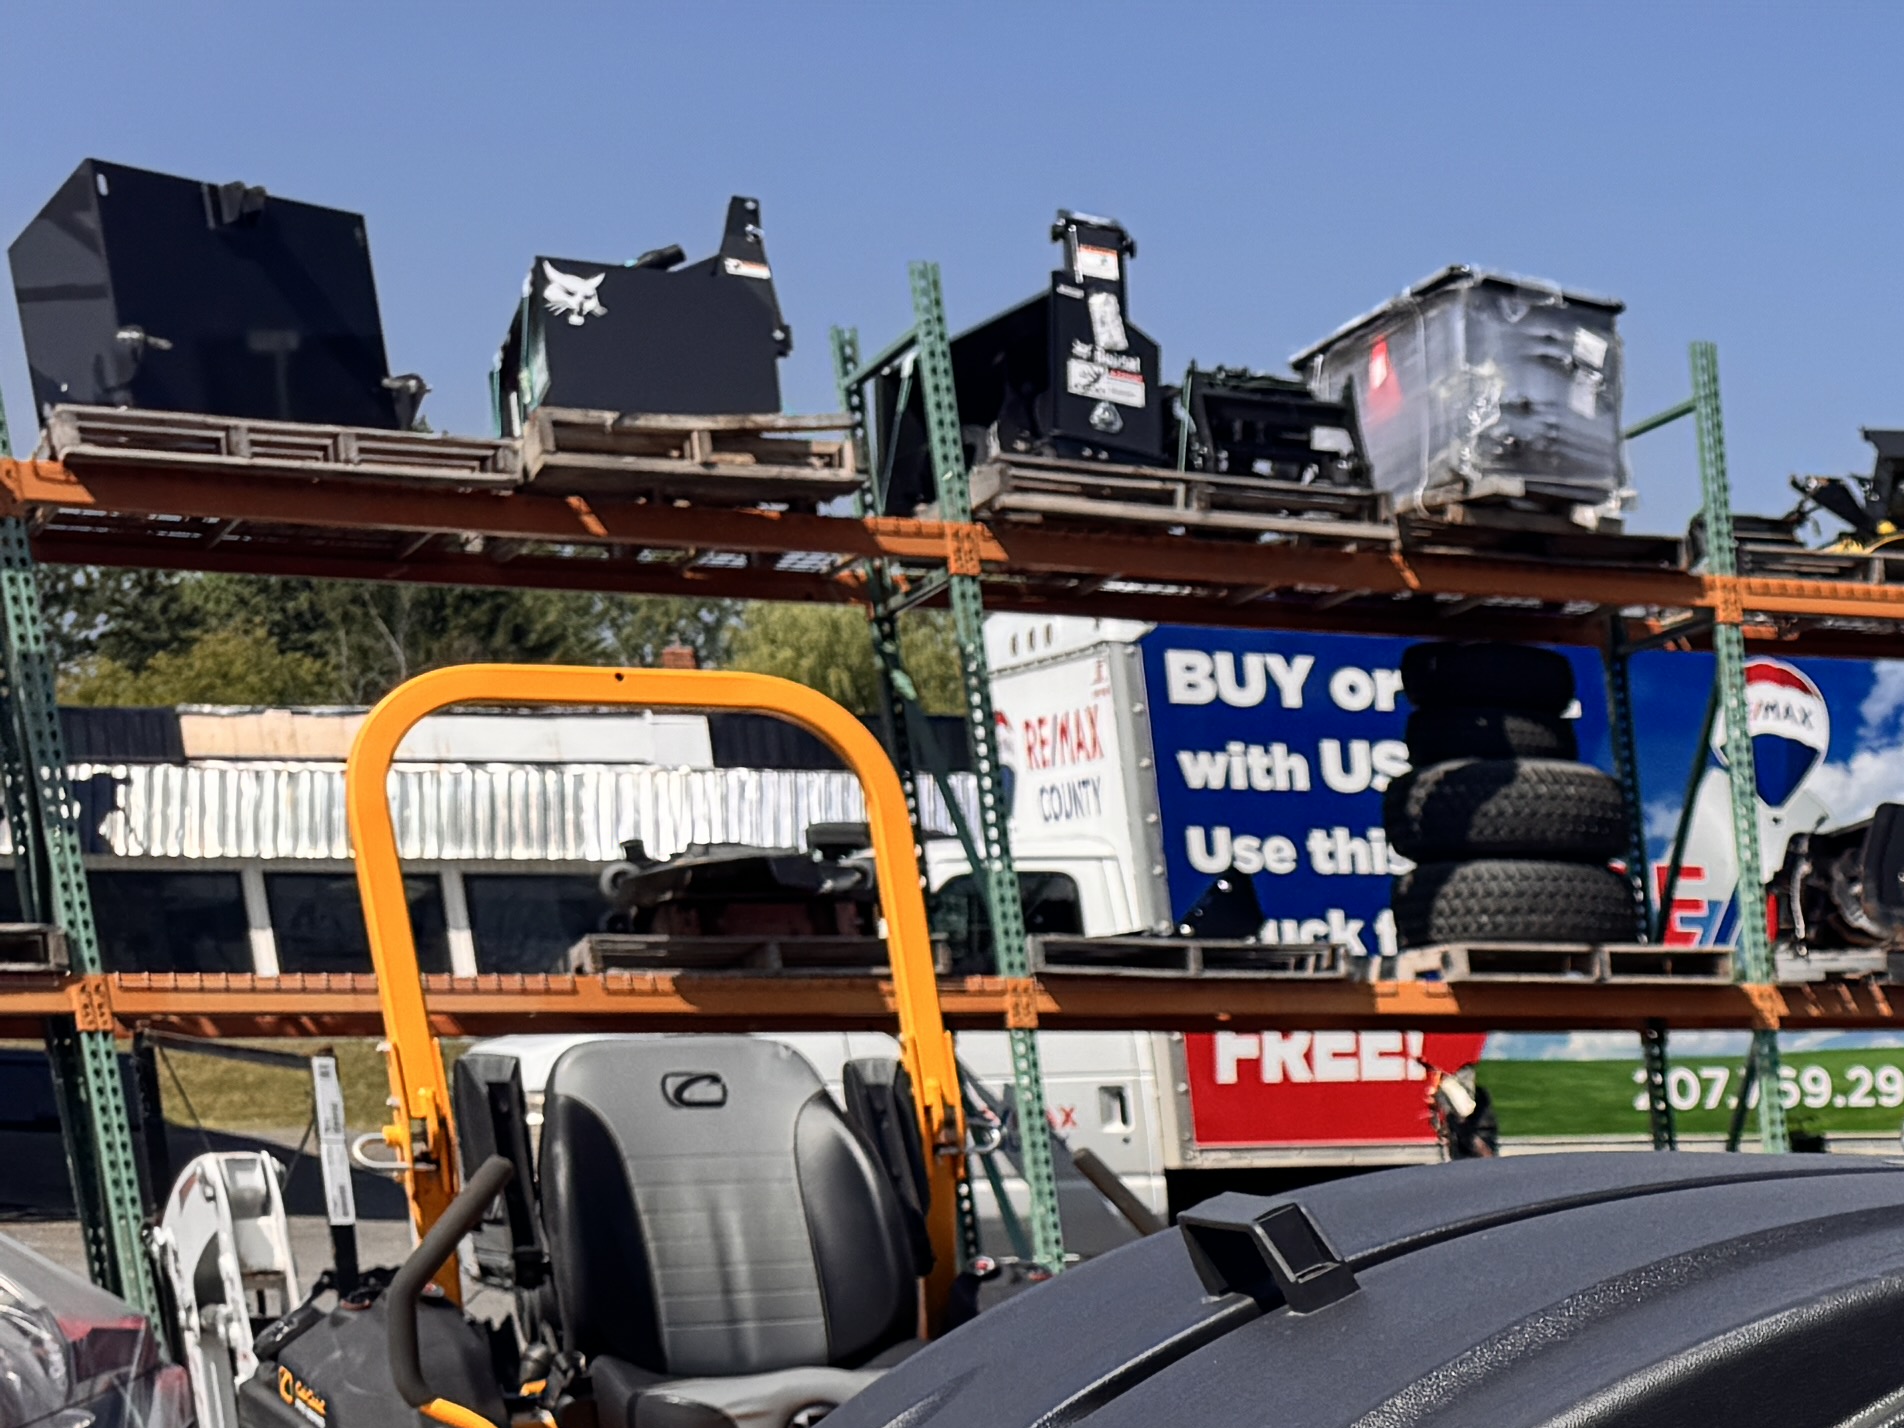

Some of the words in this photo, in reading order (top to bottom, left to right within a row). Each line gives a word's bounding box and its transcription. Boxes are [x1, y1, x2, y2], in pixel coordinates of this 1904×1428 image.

[1165, 649, 1315, 708] BUY
[1329, 667, 1404, 711] or
[1024, 703, 1104, 770] RE/MAX
[1751, 700, 1813, 729] /MAX
[1177, 741, 1311, 791] with
[1040, 776, 1102, 822] COUNTY
[1185, 825, 1297, 874] Use
[1215, 1031, 1428, 1084] FREE!
